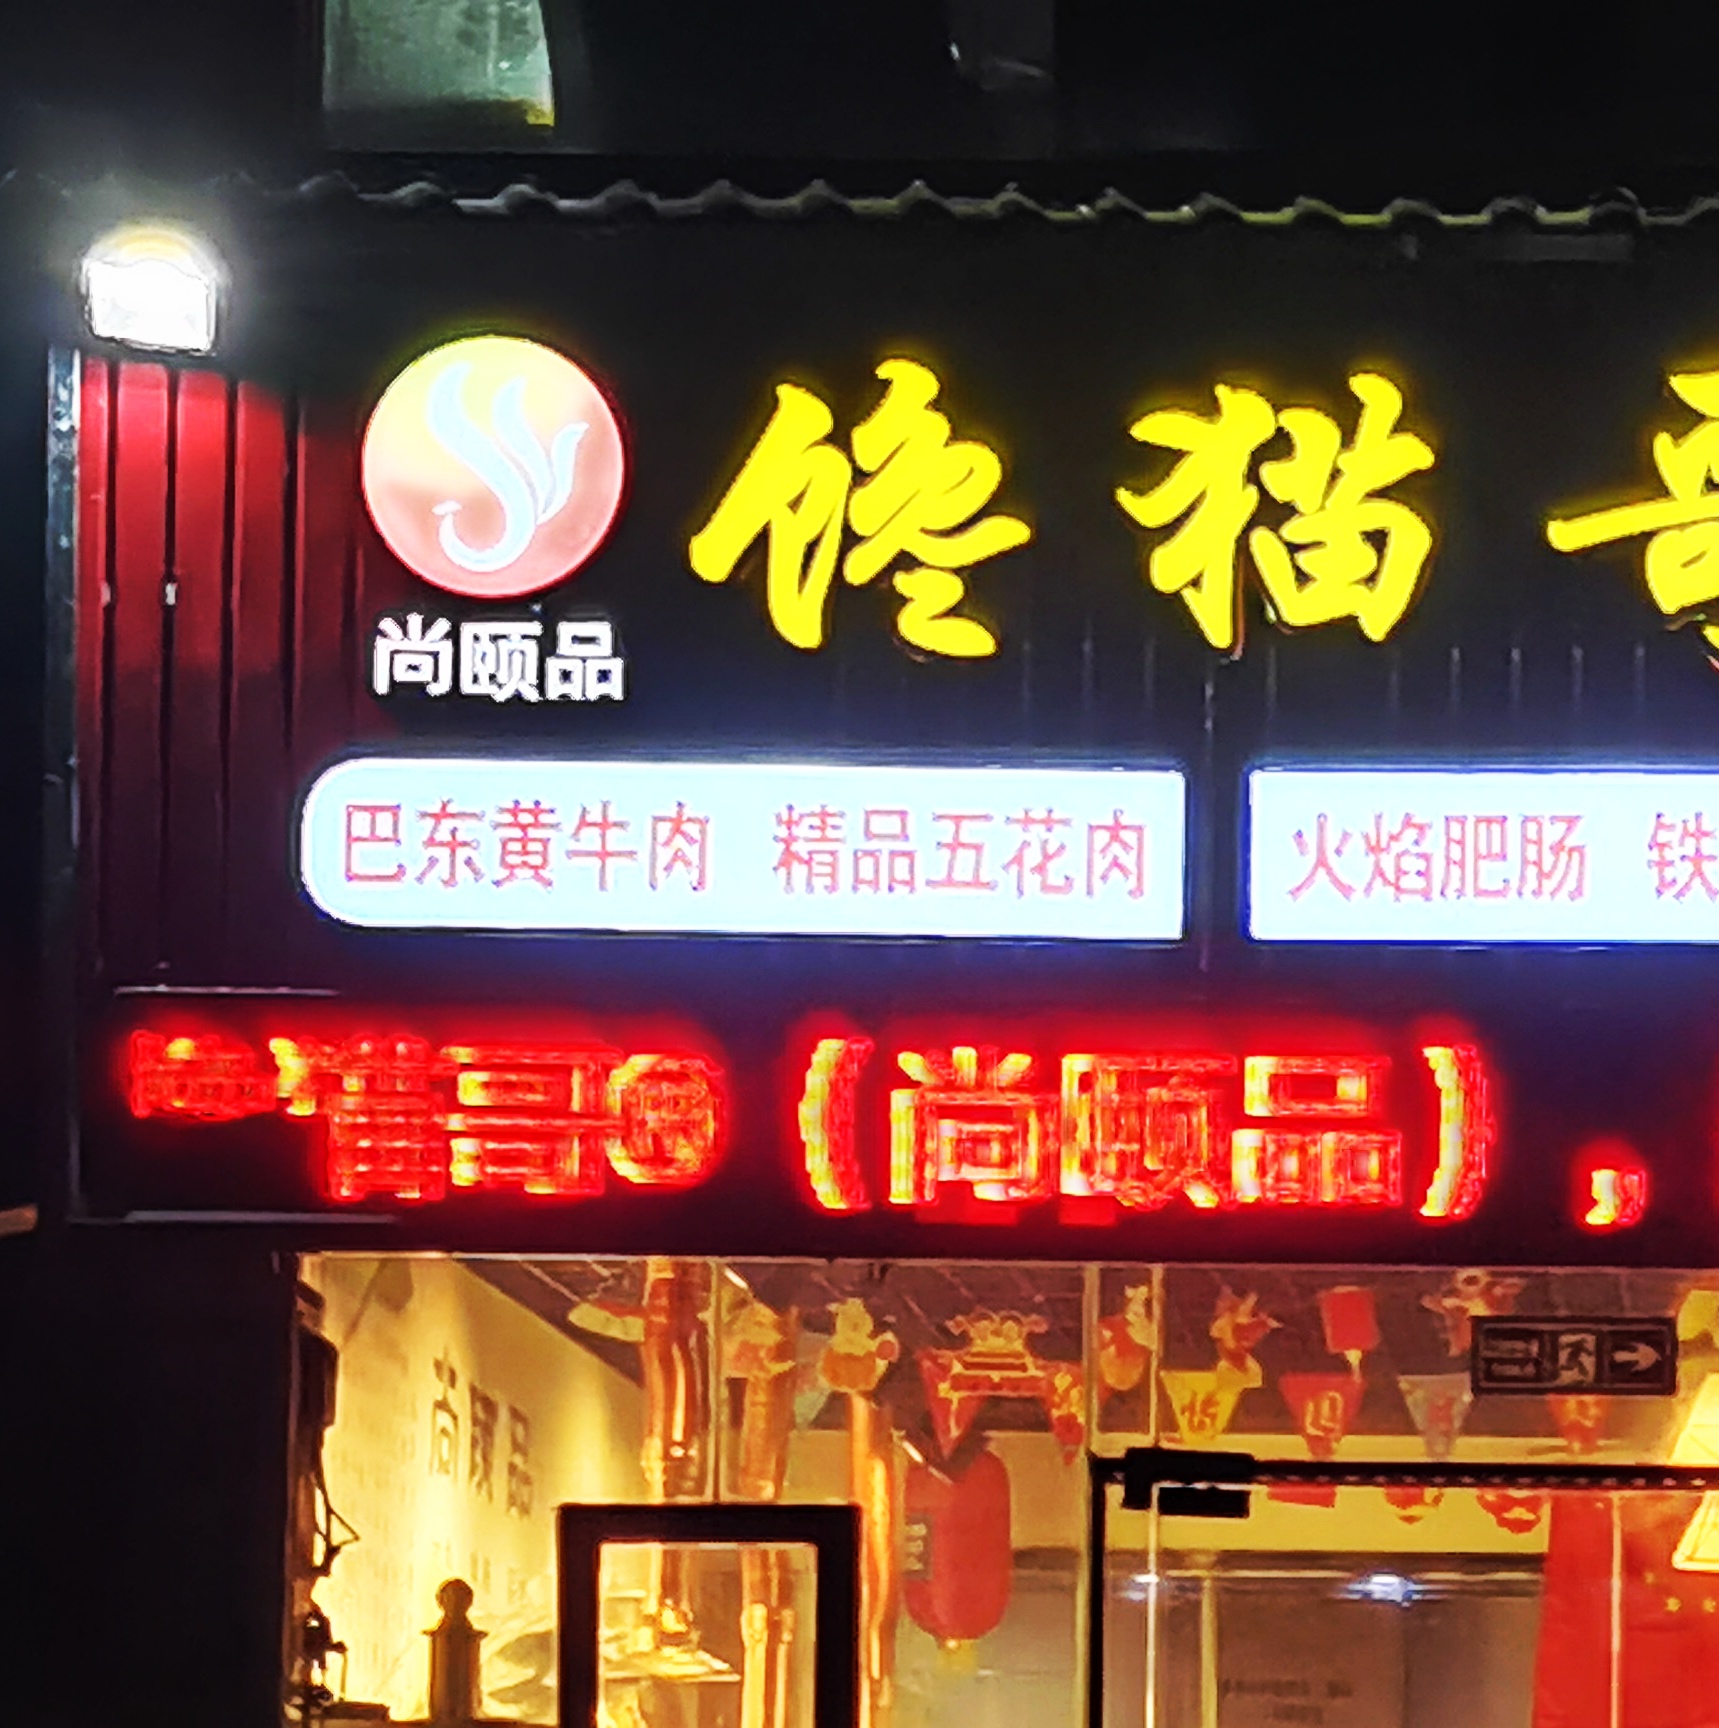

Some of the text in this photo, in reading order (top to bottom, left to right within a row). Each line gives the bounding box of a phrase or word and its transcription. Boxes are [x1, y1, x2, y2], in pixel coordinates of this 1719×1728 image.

[372, 614, 626, 703] 尚颐品
[343, 798, 1147, 901] 巴东黄牛肉 精品五花肉
[1288, 811, 1589, 904] 火焰肥肠
